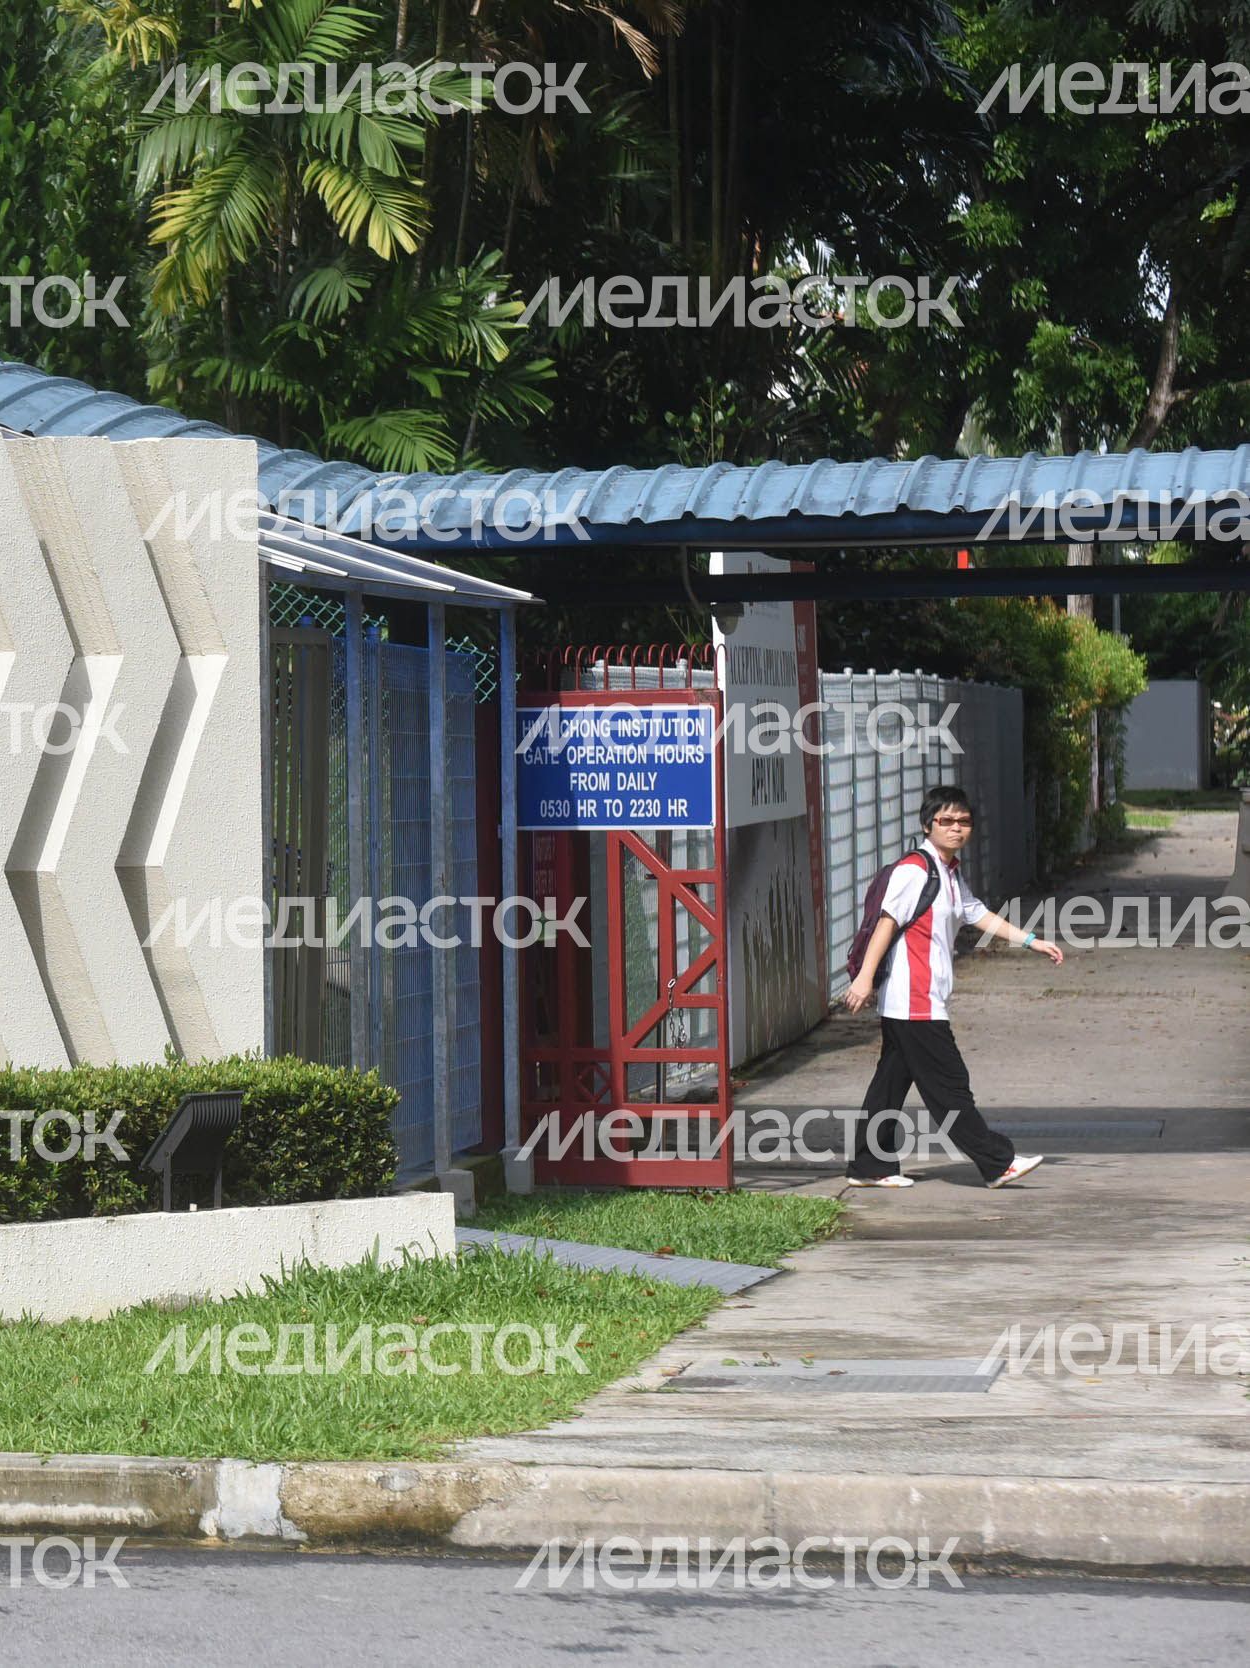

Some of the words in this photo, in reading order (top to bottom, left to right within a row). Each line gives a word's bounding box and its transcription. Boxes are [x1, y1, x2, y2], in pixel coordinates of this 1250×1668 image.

[561, 718, 611, 738] CHONG
[618, 718, 705, 737] INSTITUTION
[523, 746, 560, 765] GATE
[567, 745, 647, 765] OPERATION
[654, 745, 704, 764] HOURS
[570, 772, 610, 791] FROM
[617, 772, 657, 791] DAILY
[540, 799, 570, 818] 0530
[577, 799, 597, 818] HR
[604, 799, 623, 818] TO
[629, 799, 661, 818] 2230
[668, 799, 688, 817] HR
